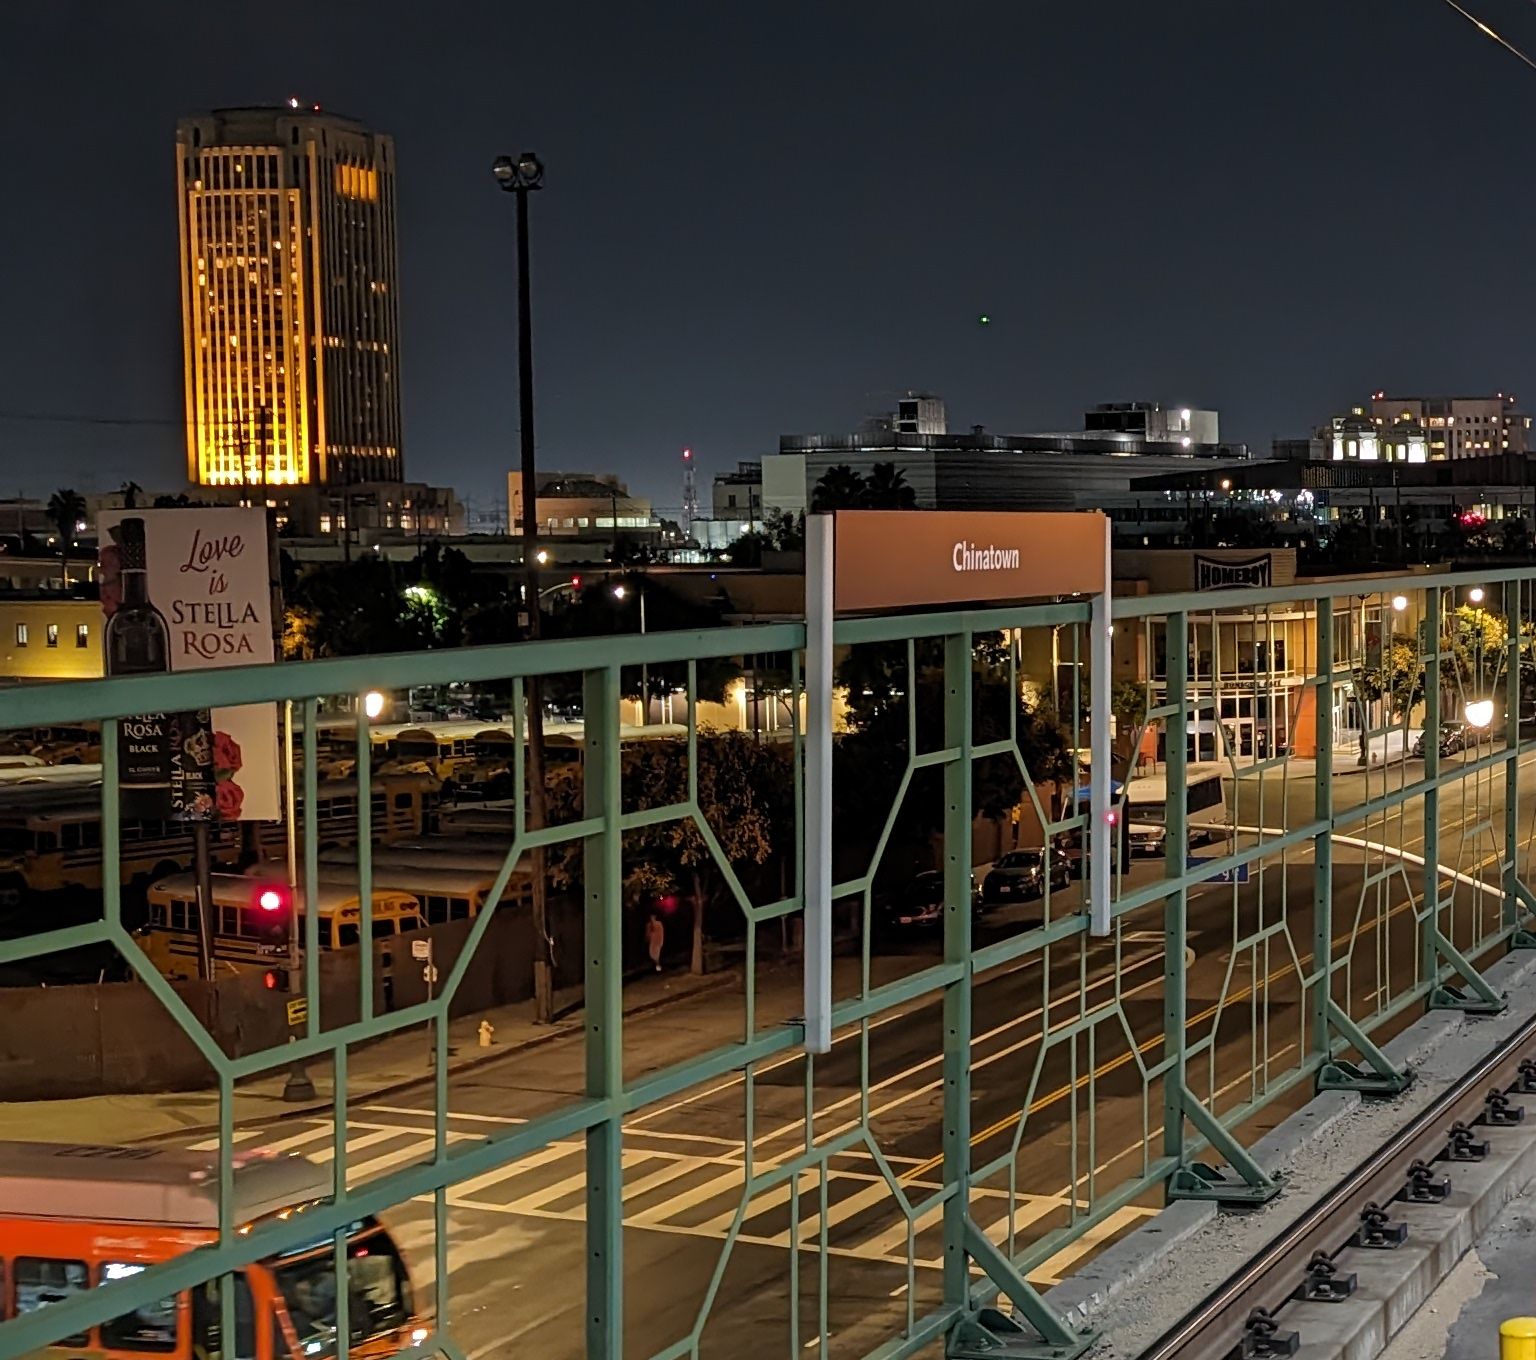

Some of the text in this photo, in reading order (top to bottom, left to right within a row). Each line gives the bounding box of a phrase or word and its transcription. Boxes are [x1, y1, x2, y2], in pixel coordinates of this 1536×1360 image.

[180, 529, 244, 573] Love
[952, 540, 1020, 571] Chinatown
[208, 570, 229, 595] is
[172, 600, 260, 629] STELLA
[183, 631, 254, 659] ROSA
[124, 723, 163, 739] ROSA
[129, 744, 159, 753] BLACK
[171, 754, 185, 809] STELLA
